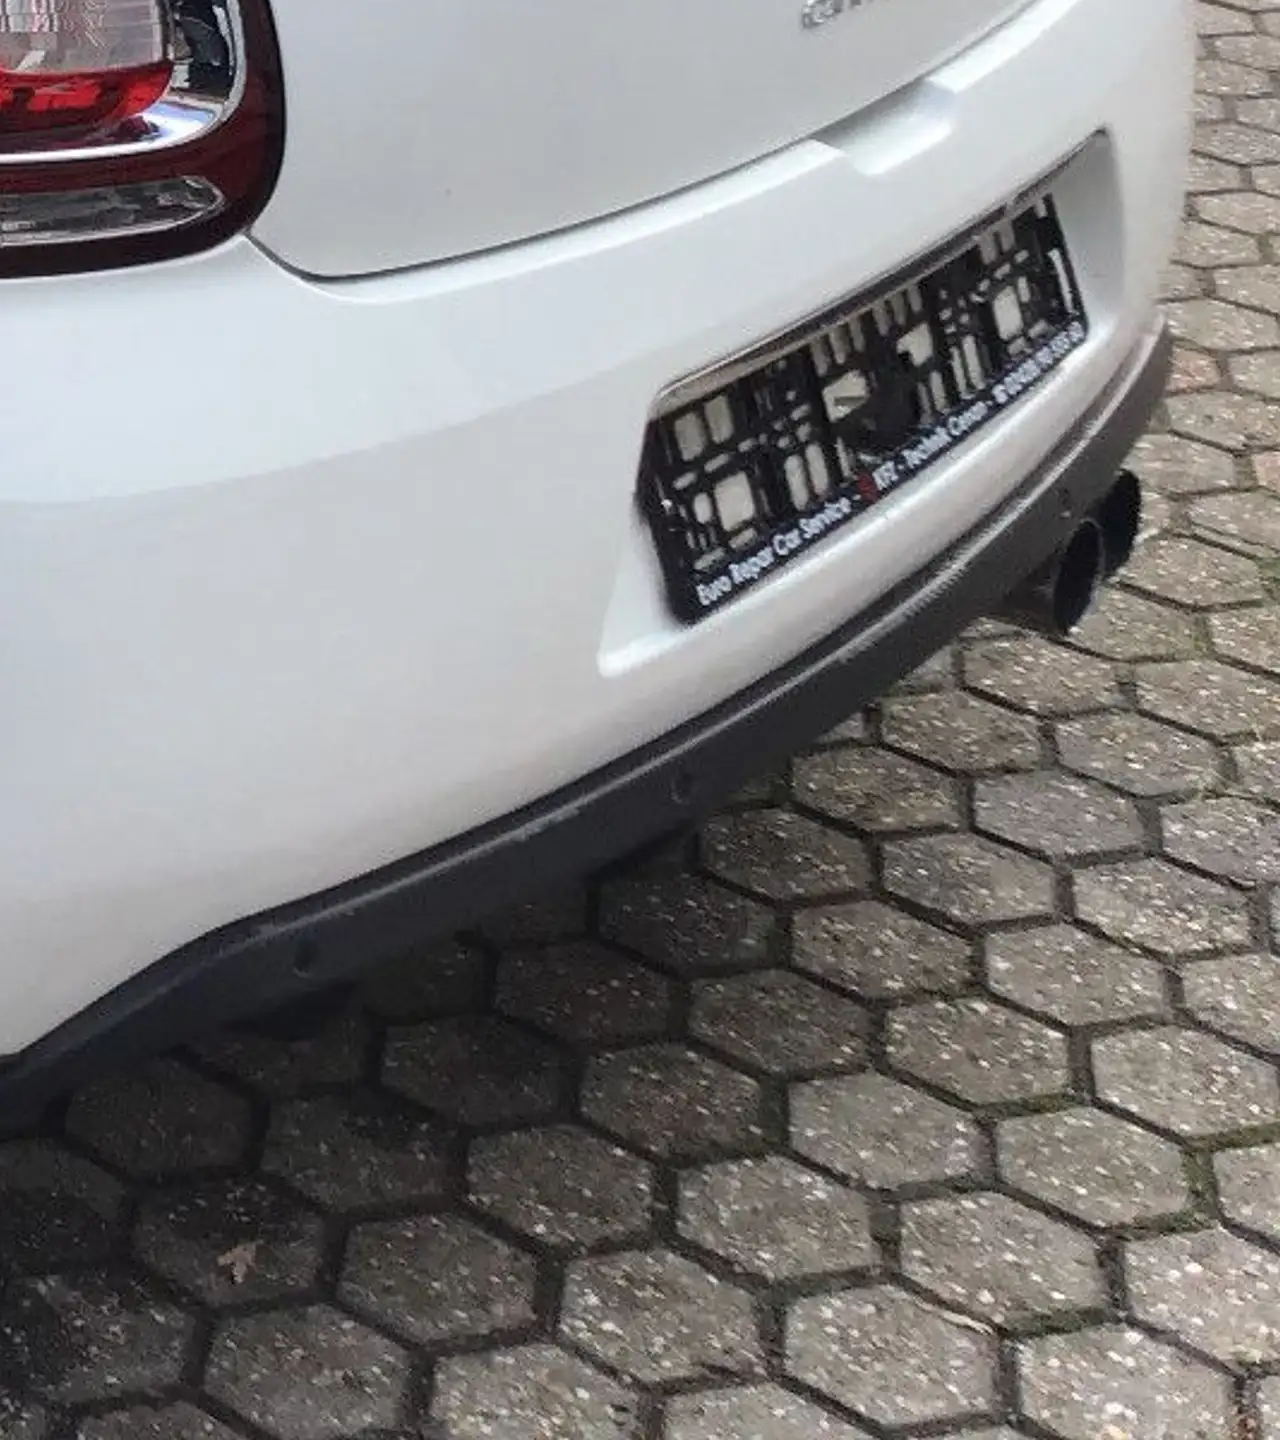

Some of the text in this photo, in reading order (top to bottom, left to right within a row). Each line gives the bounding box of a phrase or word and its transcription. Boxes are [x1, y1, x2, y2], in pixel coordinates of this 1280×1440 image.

[696, 575, 733, 607] Euro
[773, 528, 803, 556] Car
[800, 497, 852, 539] Service
